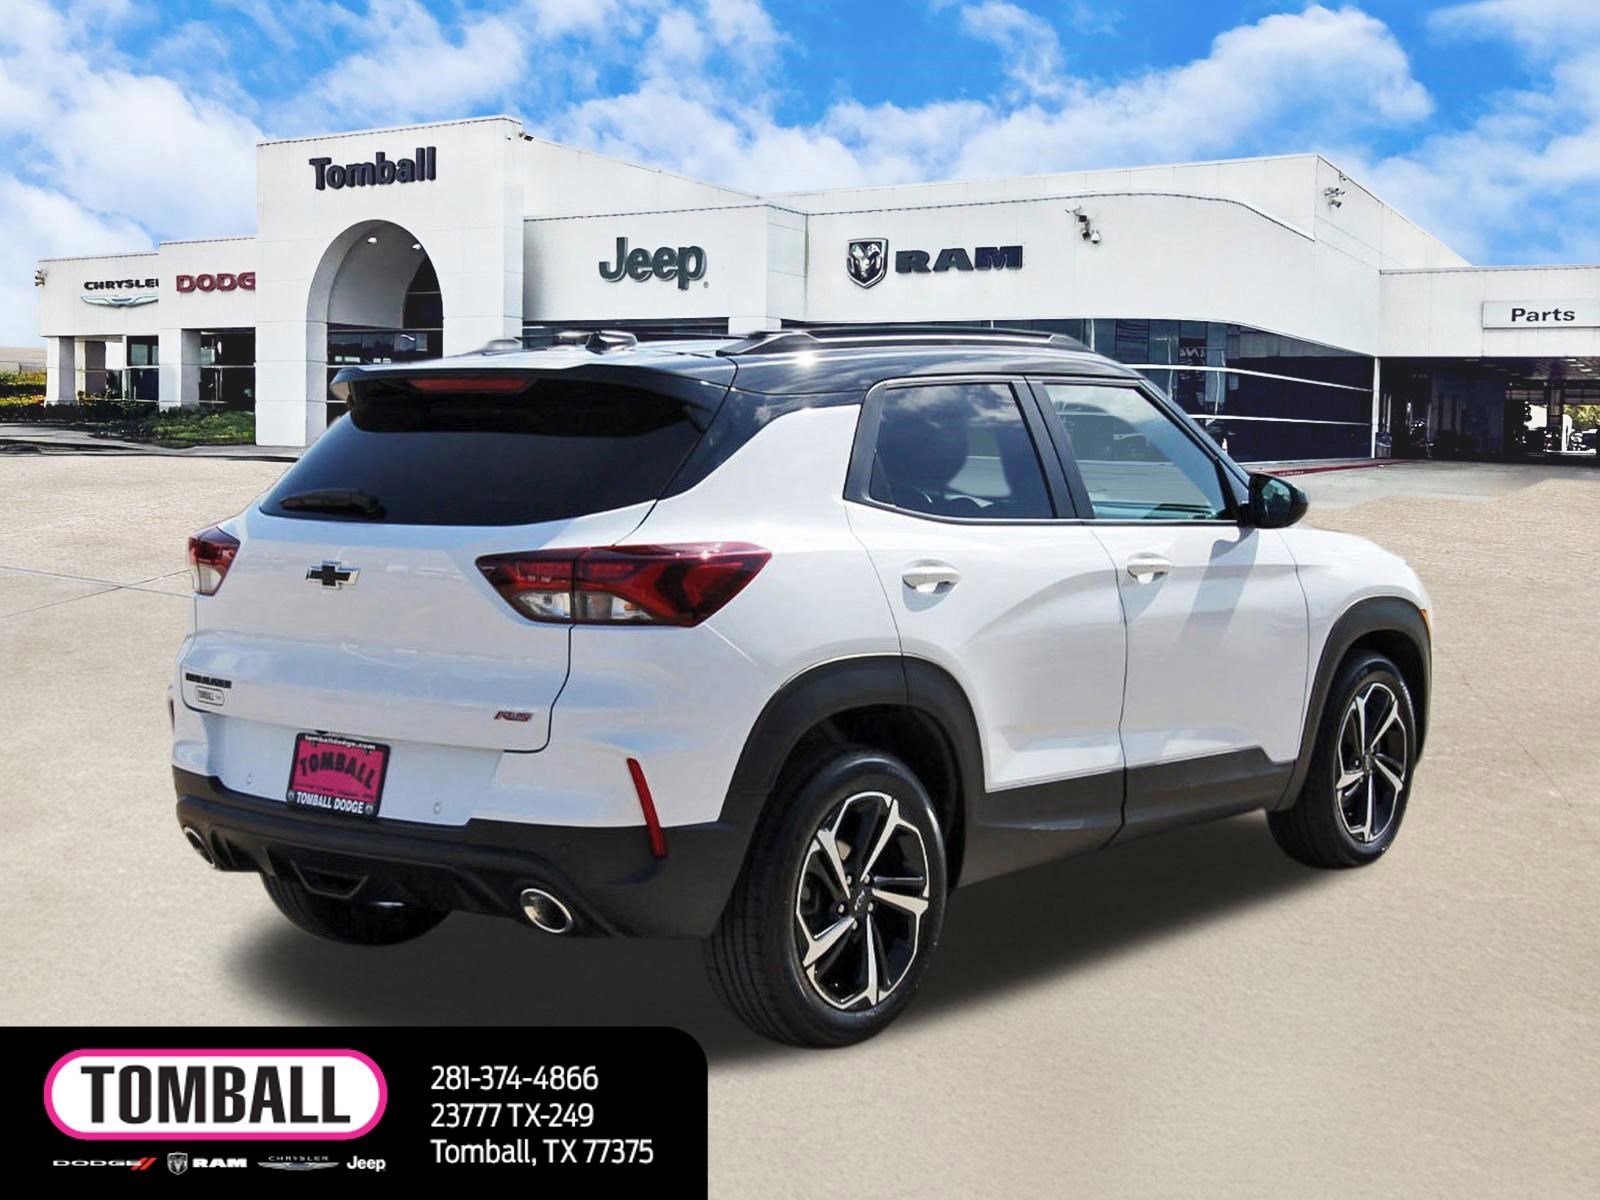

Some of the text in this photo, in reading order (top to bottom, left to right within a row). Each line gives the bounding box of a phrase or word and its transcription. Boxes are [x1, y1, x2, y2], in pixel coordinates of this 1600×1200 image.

[309, 146, 437, 191] Tomball
[599, 236, 707, 290] Jeep
[895, 245, 1023, 274] RAM
[83, 278, 159, 290] CHRYSLE
[1511, 307, 1576, 323] Parts
[300, 752, 375, 789] TOMBALL
[296, 792, 364, 814] TOMBALL DODGE
